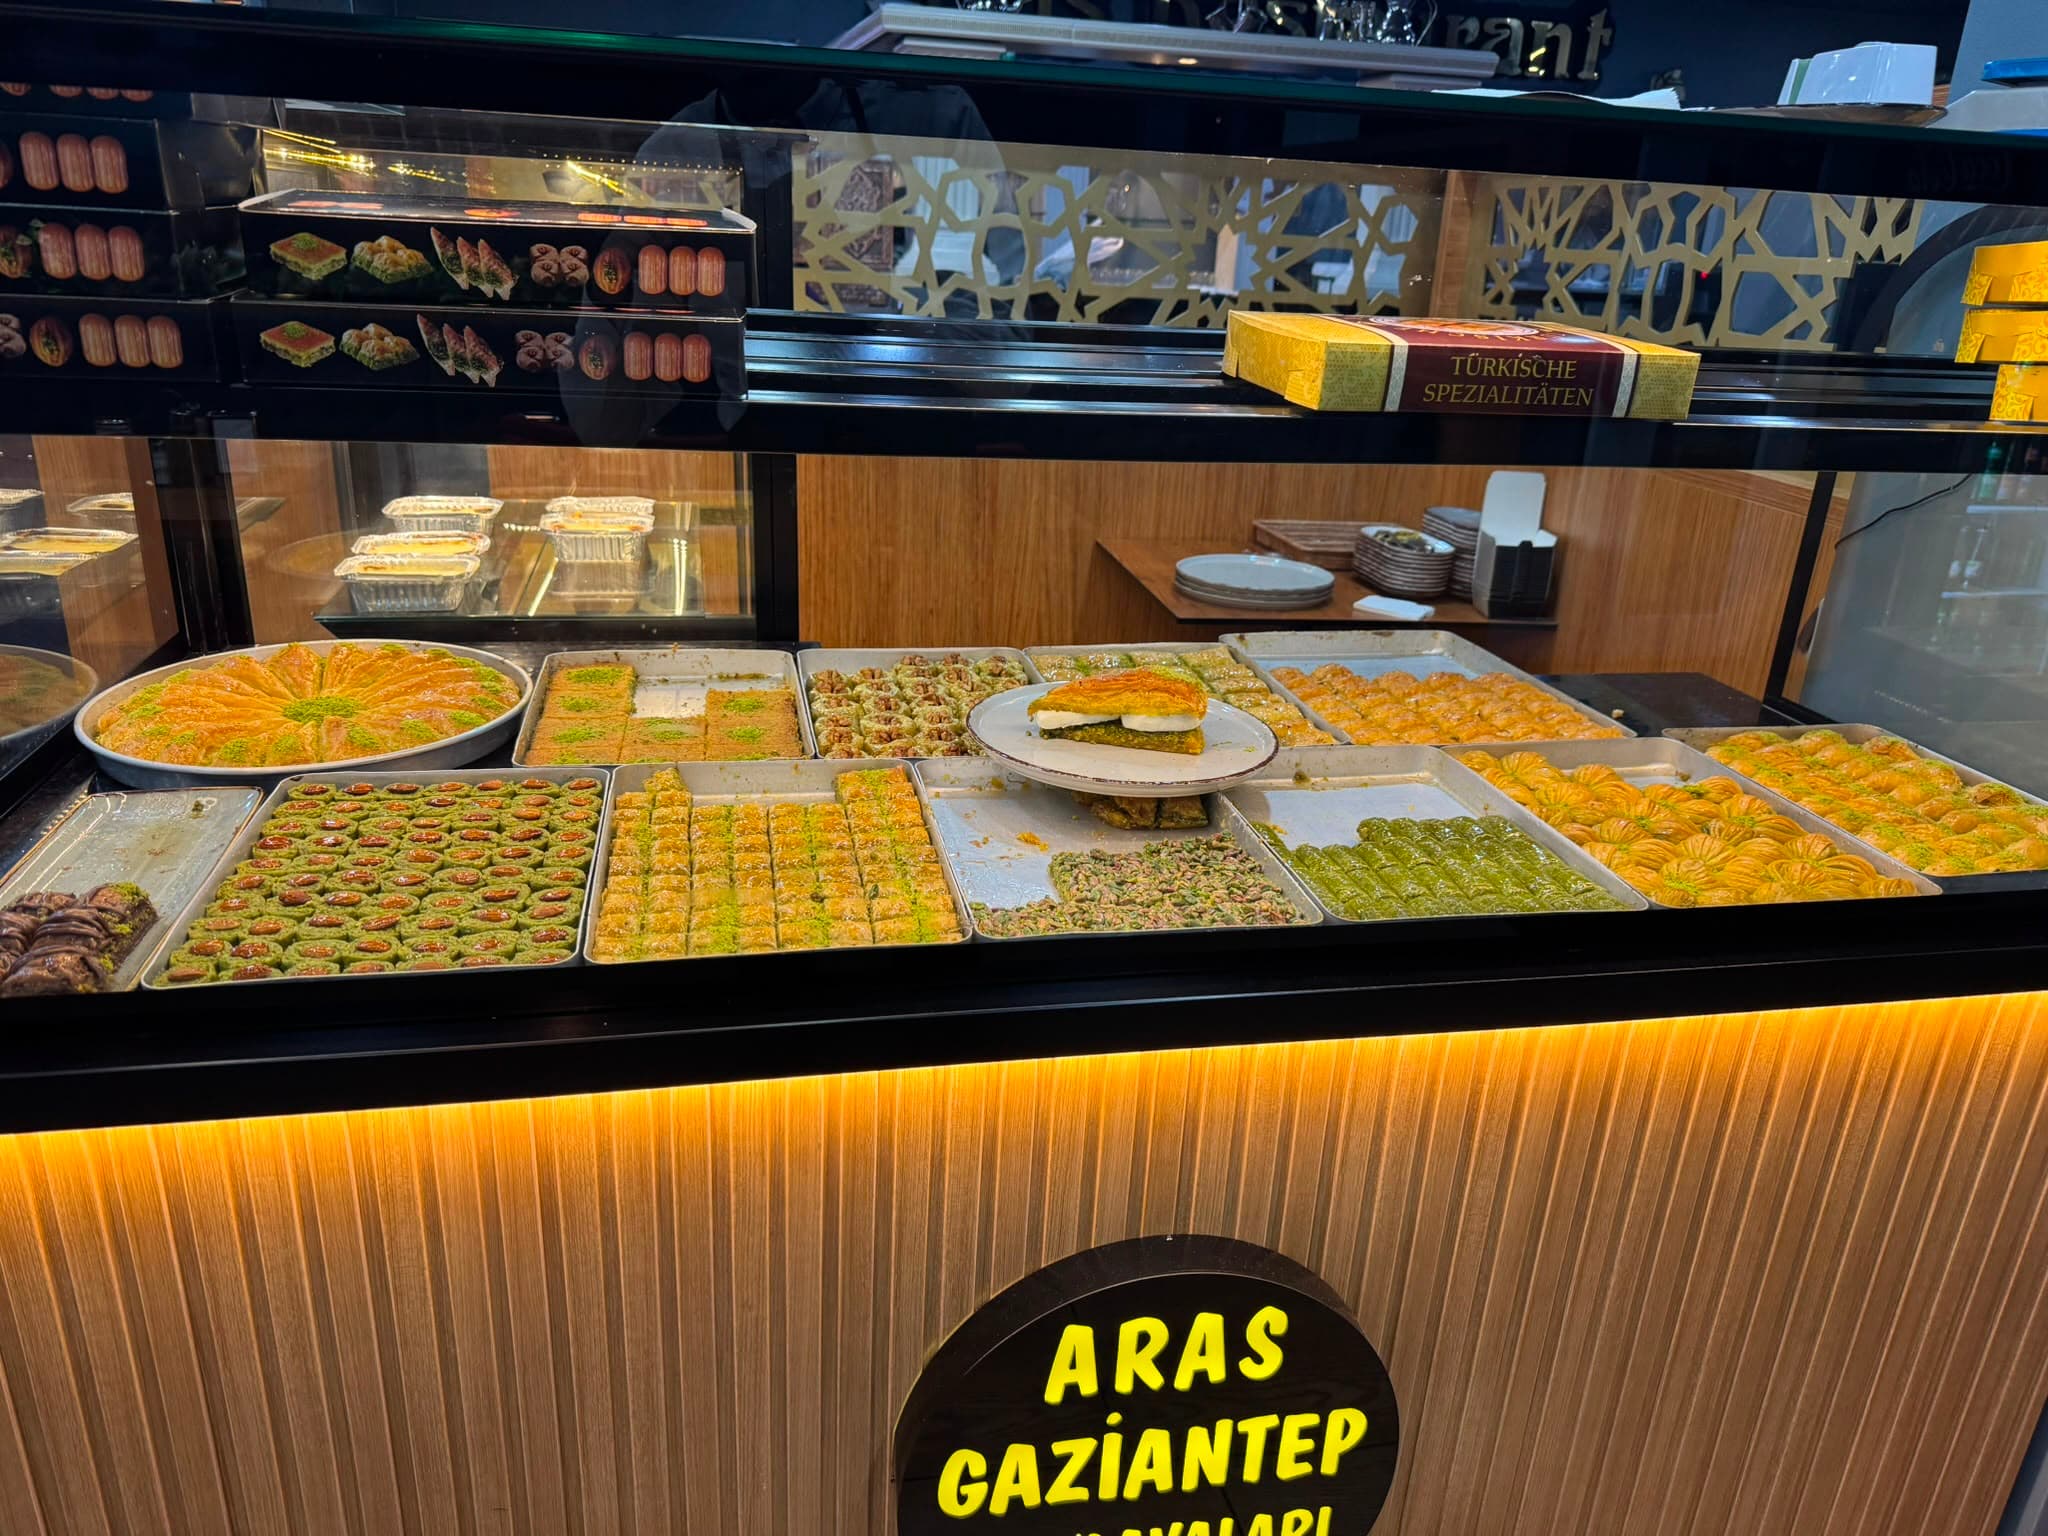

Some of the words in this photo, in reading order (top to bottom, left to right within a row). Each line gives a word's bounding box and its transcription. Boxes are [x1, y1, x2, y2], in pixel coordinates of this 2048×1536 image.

[1423, 382, 1594, 406] SPEZIALITÄTEN
[1045, 1306, 1288, 1405] ARAS
[938, 1408, 1368, 1517] GAZİANTEP
